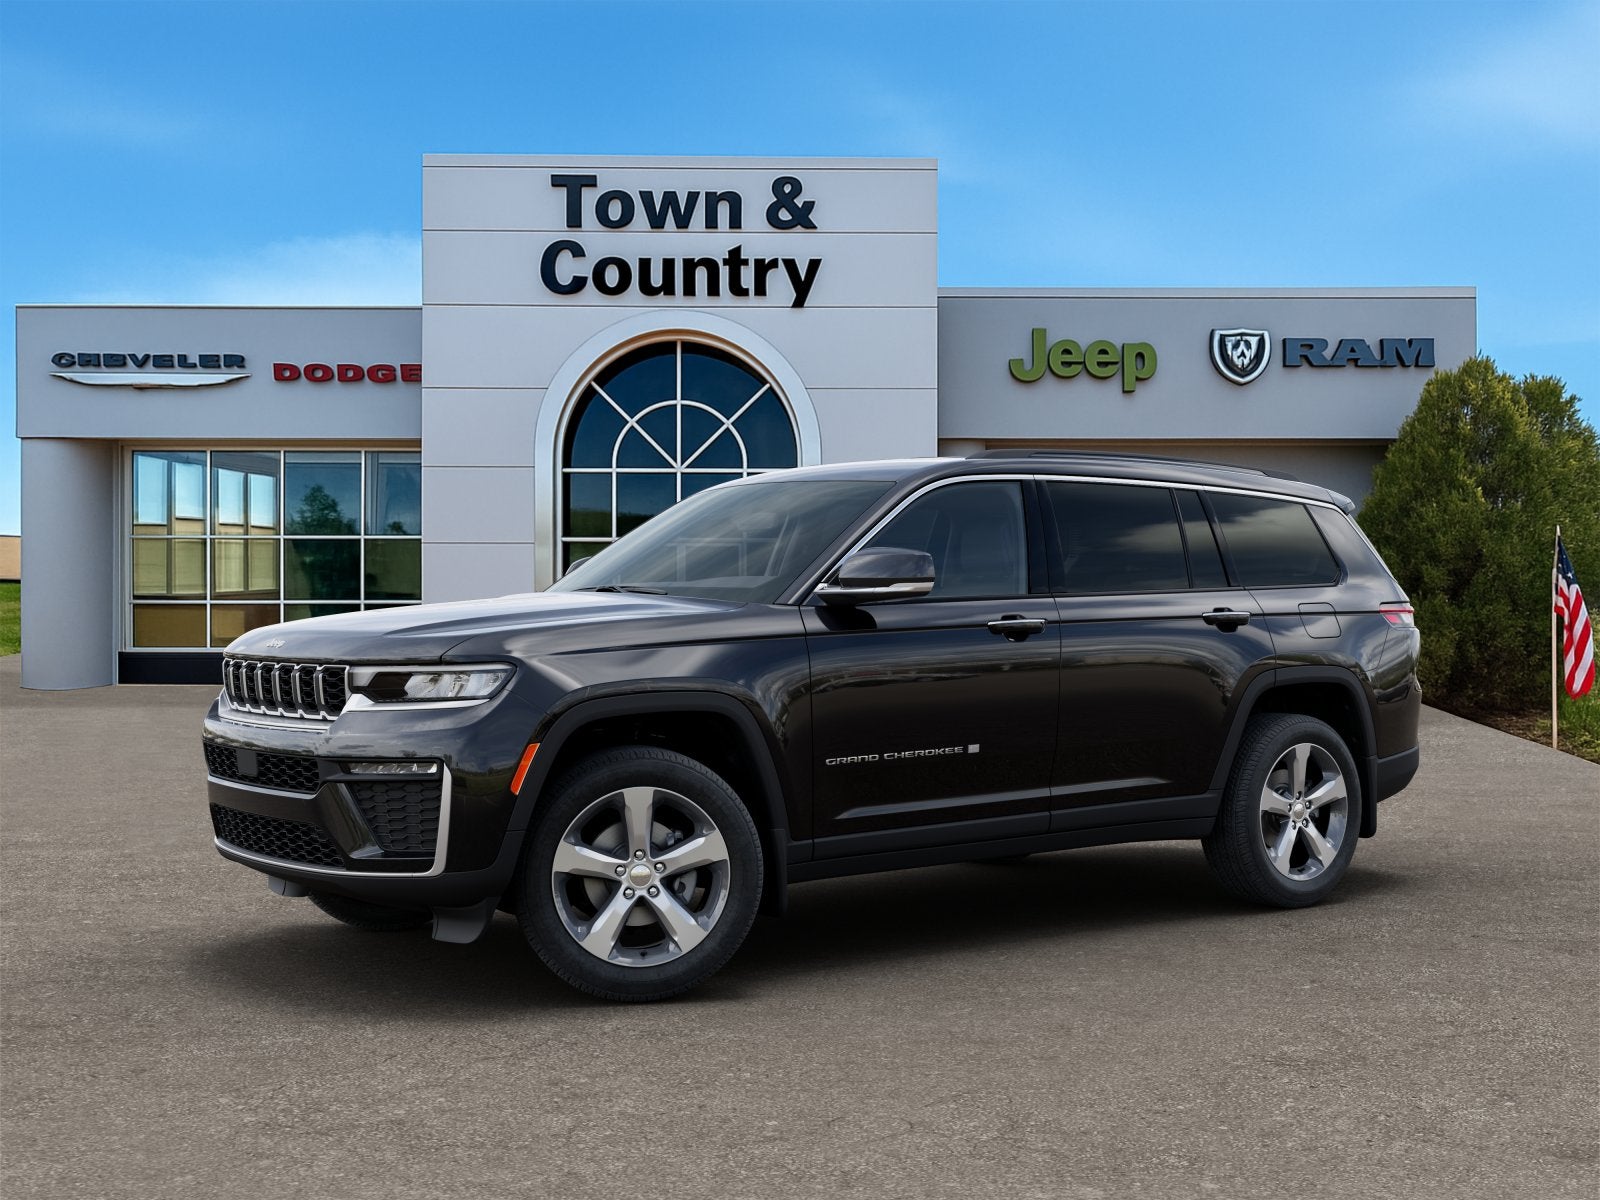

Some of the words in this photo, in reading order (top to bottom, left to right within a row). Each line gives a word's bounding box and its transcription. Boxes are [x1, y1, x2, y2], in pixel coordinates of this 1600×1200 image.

[550, 174, 743, 229] Town
[765, 176, 818, 230] &
[540, 239, 822, 308] Country
[273, 363, 422, 383] DODGE
[1009, 328, 1157, 393] Jeep
[1283, 337, 1435, 368] RAM
[825, 754, 879, 766] GRAND
[883, 746, 964, 760] CHEROKEE
